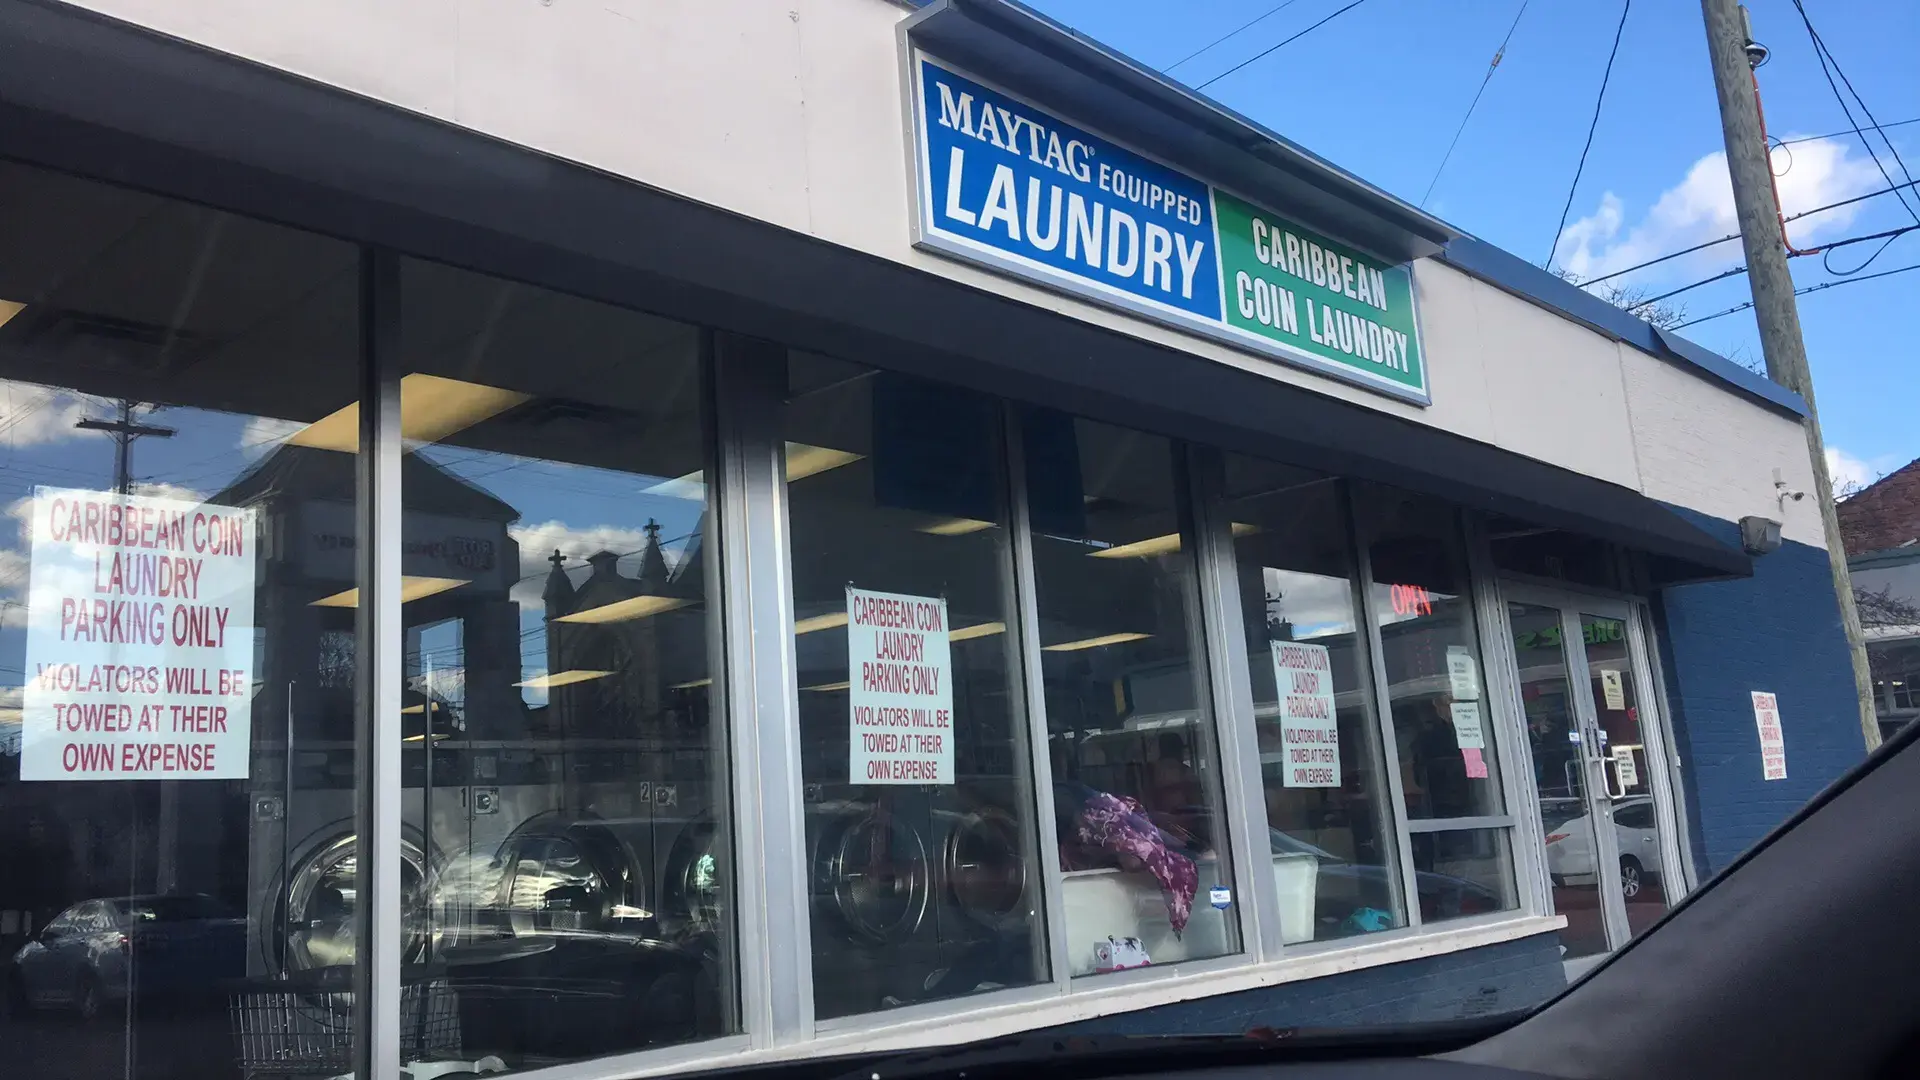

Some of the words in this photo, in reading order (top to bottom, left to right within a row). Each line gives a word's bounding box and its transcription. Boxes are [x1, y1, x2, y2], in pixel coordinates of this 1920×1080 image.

[1099, 163, 1201, 226] EQUIPPED
[945, 147, 1204, 299] LAUNDRY
[1251, 217, 1388, 312] CARIBBEAN
[1236, 270, 1298, 336] COIN
[1306, 297, 1409, 374] LAUNDRY
[50, 498, 186, 551] CARIBBEAN
[192, 512, 243, 557] COIN
[94, 551, 203, 599] LAUNDRY
[854, 595, 915, 630] CARIBBEAN
[917, 602, 942, 632] COIN
[1391, 584, 1432, 616] OPEN
[60, 597, 164, 646] PARKING
[172, 604, 229, 648] ONLY
[875, 630, 924, 662] LAUNDRY
[37, 663, 159, 694] VIOLATORS
[165, 667, 212, 695] WILL
[219, 669, 244, 696] BE
[863, 662, 910, 694] PARKING
[912, 665, 939, 696] ONLY
[53, 703, 132, 732] TOWED
[137, 704, 164, 732] AT
[170, 706, 227, 733] THEIR
[854, 706, 909, 727] VIOLATORS
[911, 708, 934, 728] WILL
[936, 709, 949, 728] BE
[862, 733, 898, 753] TOWED
[899, 734, 912, 753] AT
[914, 734, 942, 754] THEIR
[1284, 728, 1315, 743] VIOLATORS
[1316, 729, 1328, 744] WILL
[1329, 729, 1337, 744] BE
[63, 743, 114, 772] OWN
[121, 744, 215, 771] EXPENSE
[867, 760, 890, 780] OWN
[893, 760, 937, 780] EXPENSE
[1290, 748, 1310, 763] TOWED
[1311, 749, 1318, 763] AT
[1318, 748, 1335, 764] THEIR
[1293, 768, 1308, 783] OWN
[1308, 768, 1333, 783] EXPENSE
